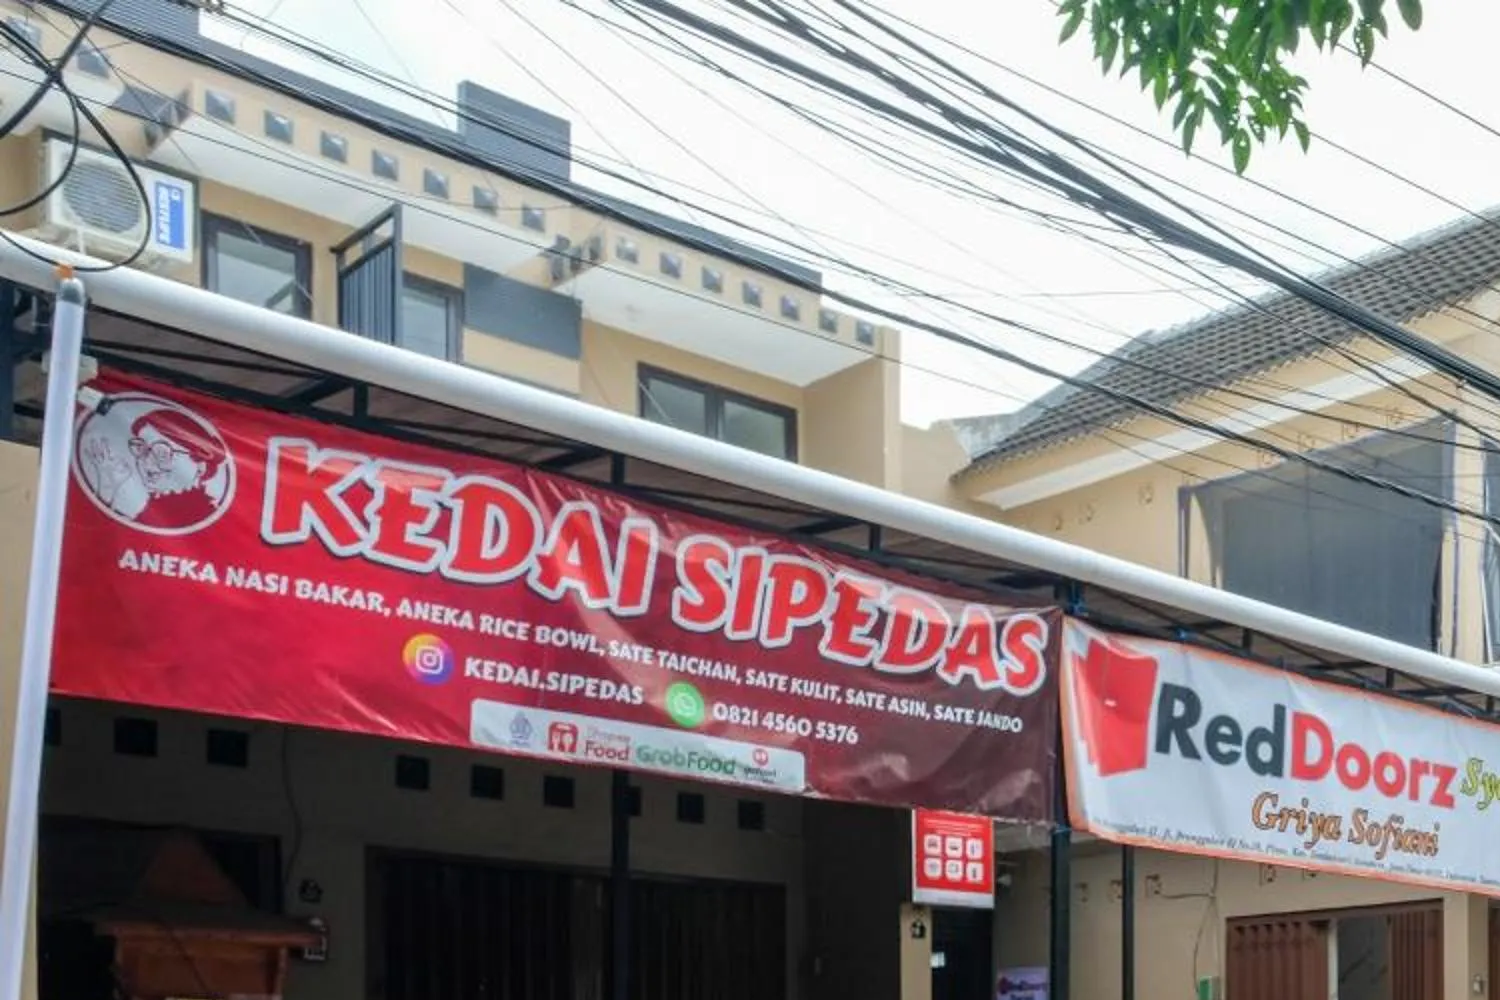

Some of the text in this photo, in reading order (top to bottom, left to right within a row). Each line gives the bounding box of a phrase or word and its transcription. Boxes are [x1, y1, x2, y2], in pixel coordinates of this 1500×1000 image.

[261, 436, 1049, 696] KEDAI SIPEDAS
[118, 549, 1024, 733] ANEKA NASI BAKAR, ANEKA RICE BOWL, SATE TAICHAN, SATE KULIT, SATE ASIN, SATE JANDO
[464, 656, 645, 705] KEDAI.SIPEDAS
[712, 701, 860, 745] 0821 4560 5376
[1155, 682, 1458, 810] RedDoorz
[585, 739, 631, 761] Food
[636, 744, 737, 776] GrabFood
[1251, 791, 1343, 849] Griya
